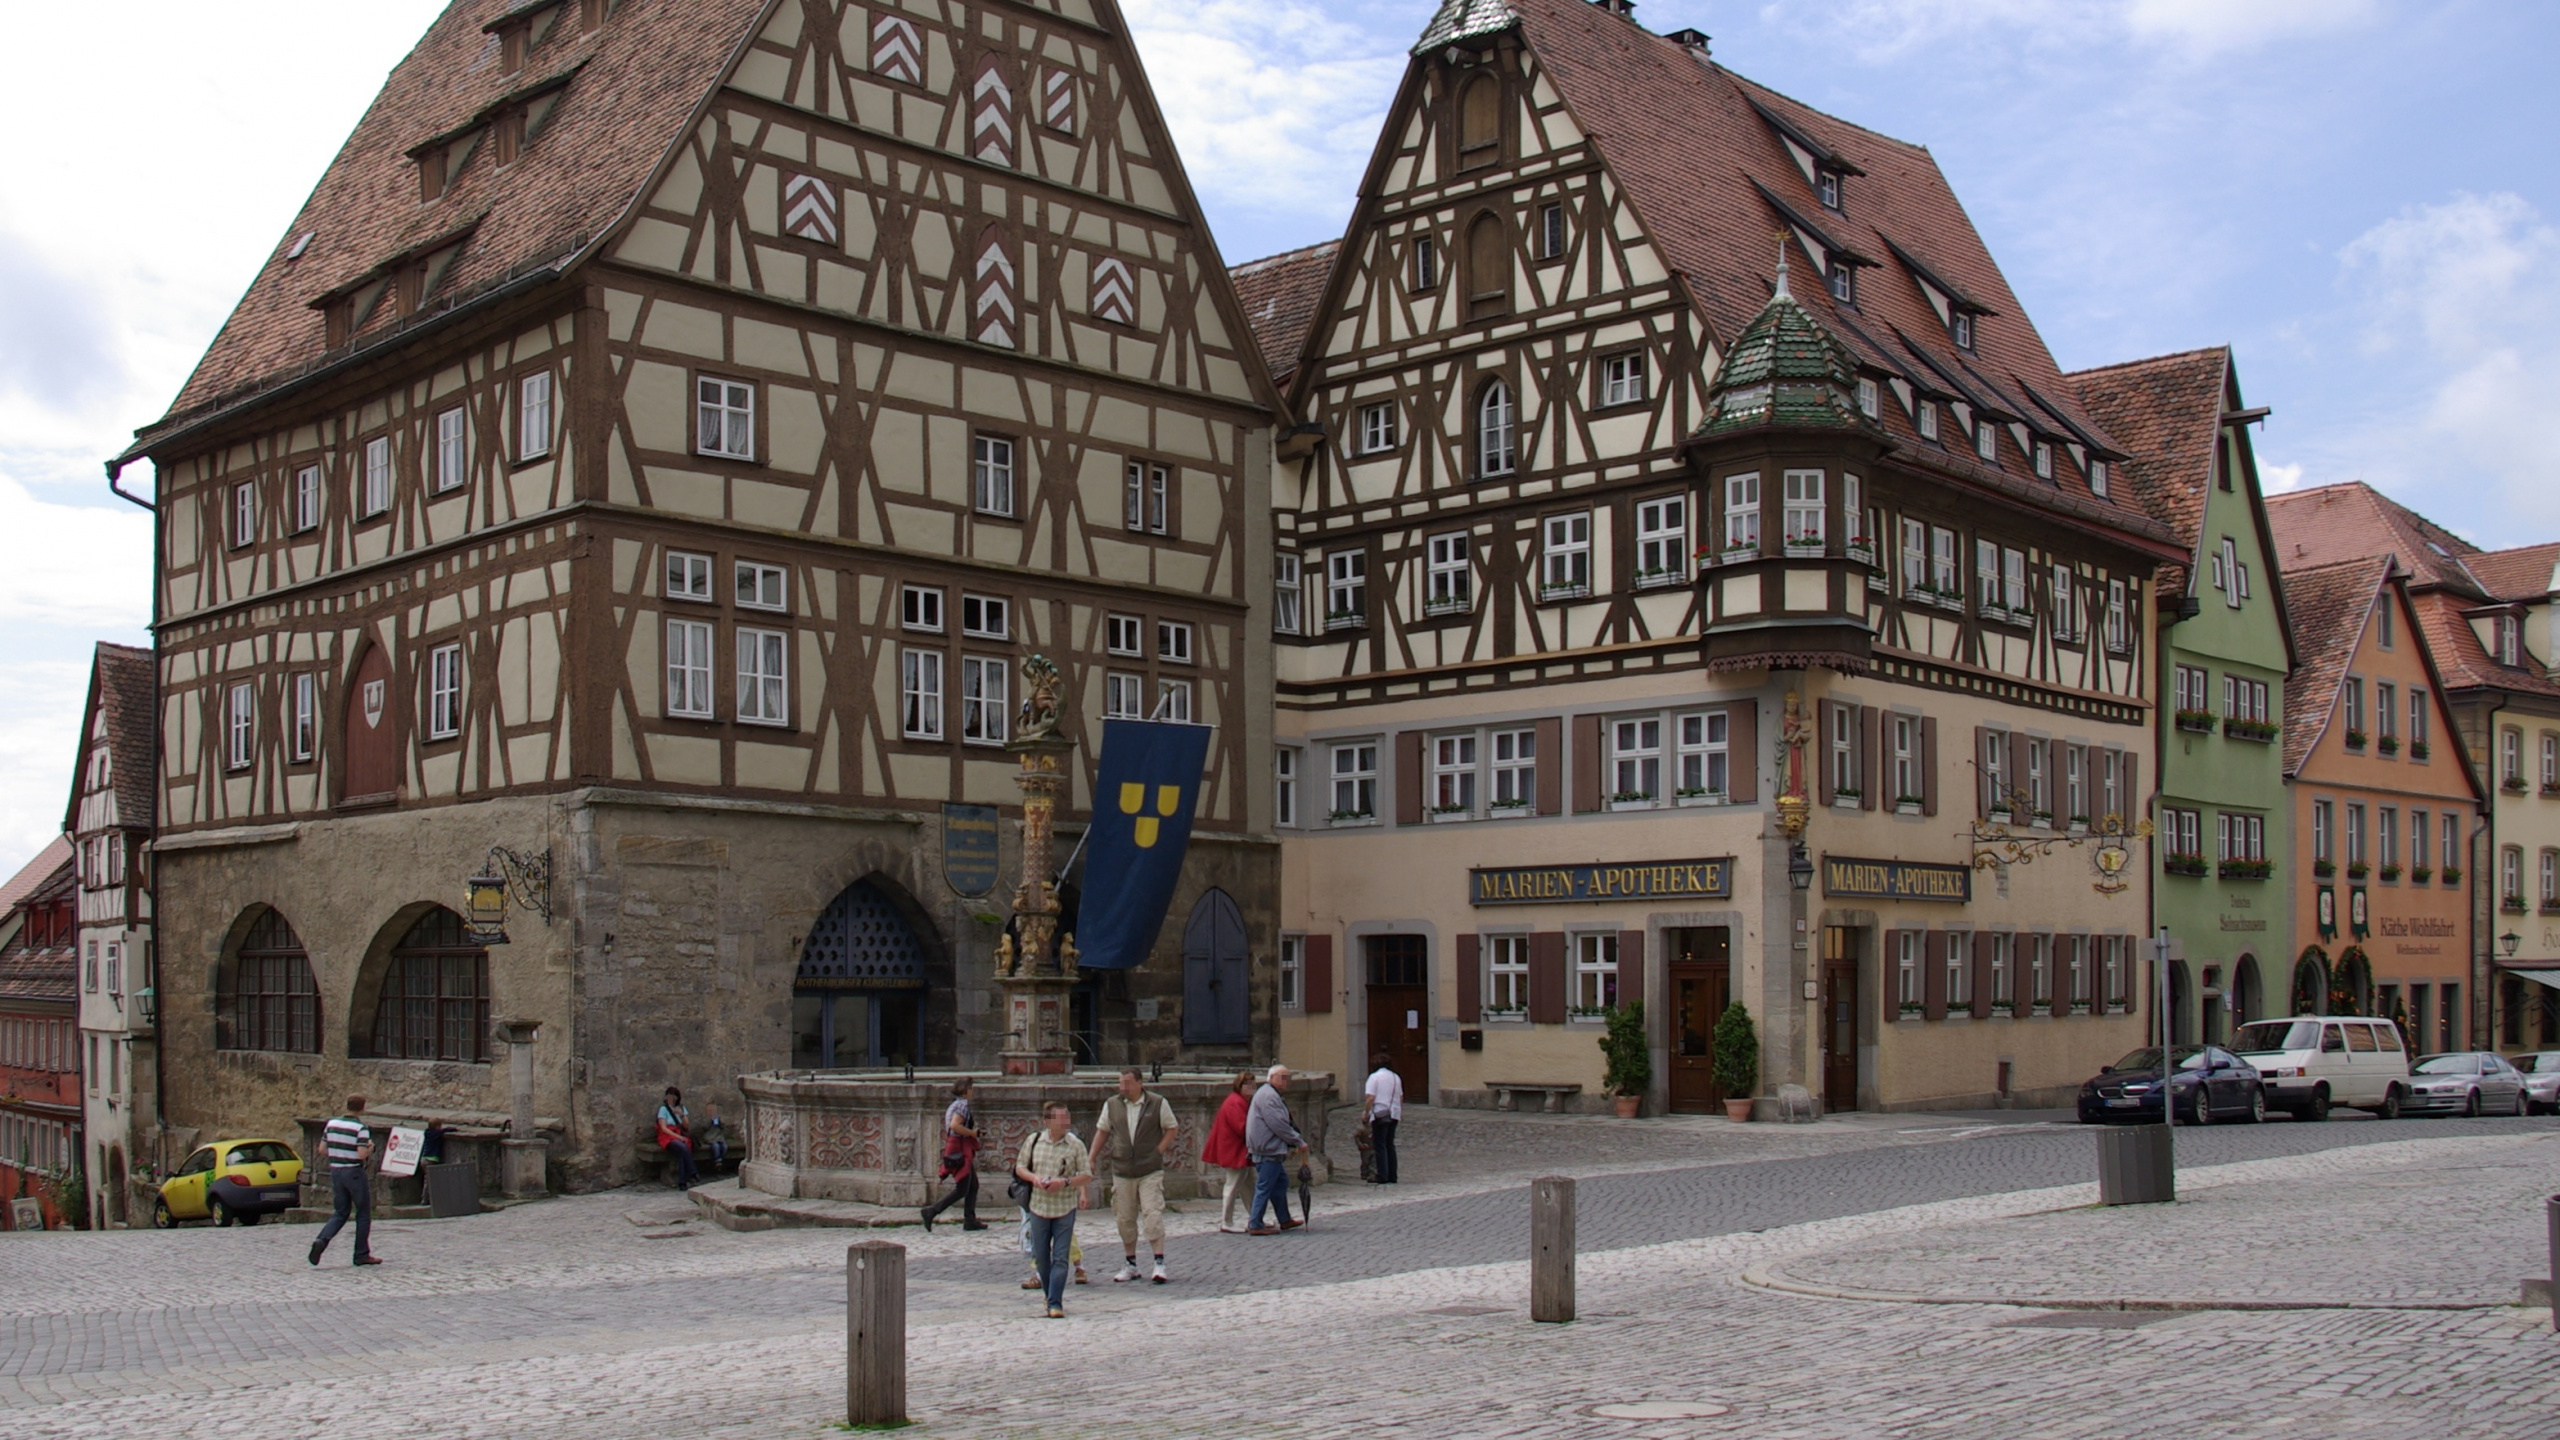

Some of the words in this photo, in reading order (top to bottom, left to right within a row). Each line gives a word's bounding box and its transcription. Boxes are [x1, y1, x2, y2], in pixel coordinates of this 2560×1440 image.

[2380, 916, 2408, 936] Käthe
[2409, 916, 2455, 937] Wohlfahrt
[796, 978, 861, 989] ROTHENBURGER
